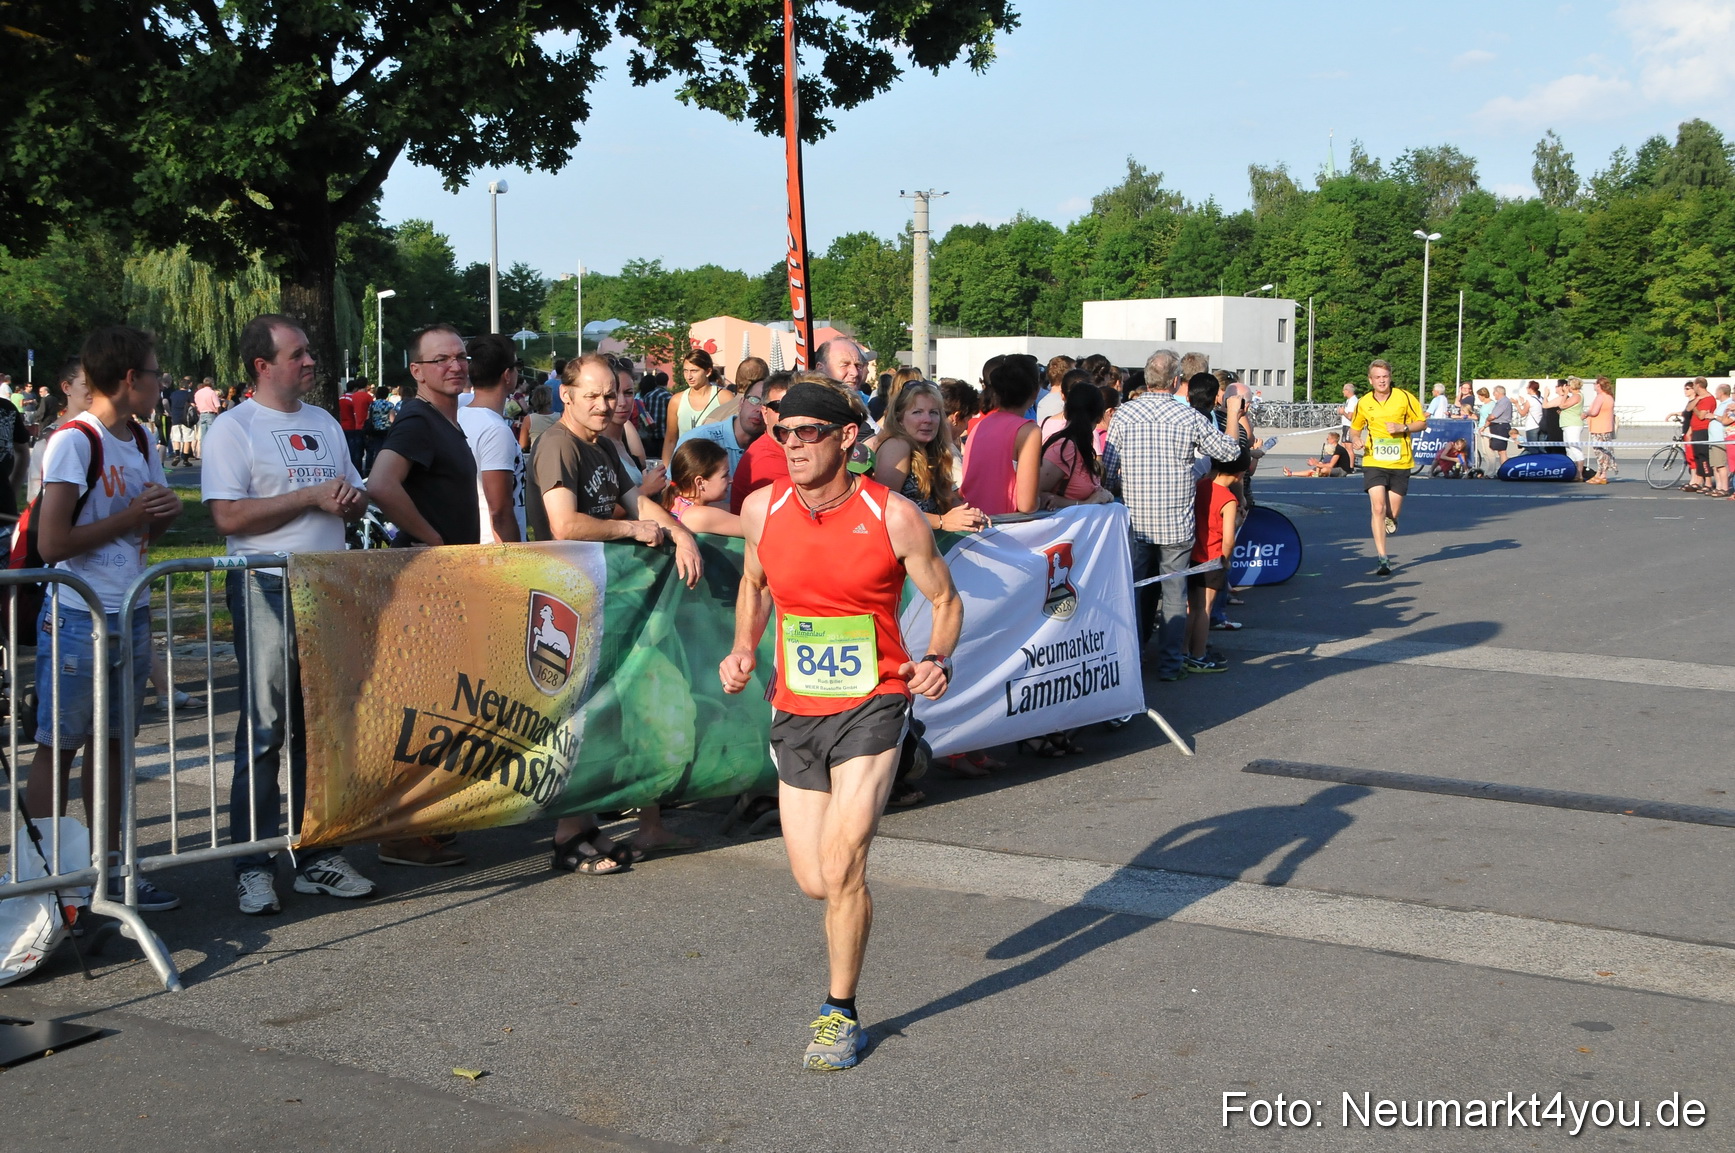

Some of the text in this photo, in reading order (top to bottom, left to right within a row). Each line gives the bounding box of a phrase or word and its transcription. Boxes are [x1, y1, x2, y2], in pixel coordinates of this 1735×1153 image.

[1374, 446, 1399, 455] 1300
[287, 467, 337, 478] POLGER
[1518, 467, 1567, 478] Fischer
[1233, 540, 1285, 558] cher
[1232, 559, 1279, 568] OMOBILE
[1049, 600, 1072, 616] 1628
[1020, 630, 1105, 670] Neumarkter
[796, 645, 862, 677] 845
[537, 664, 559, 687] 1628
[1006, 655, 1120, 717] Lammsbräu
